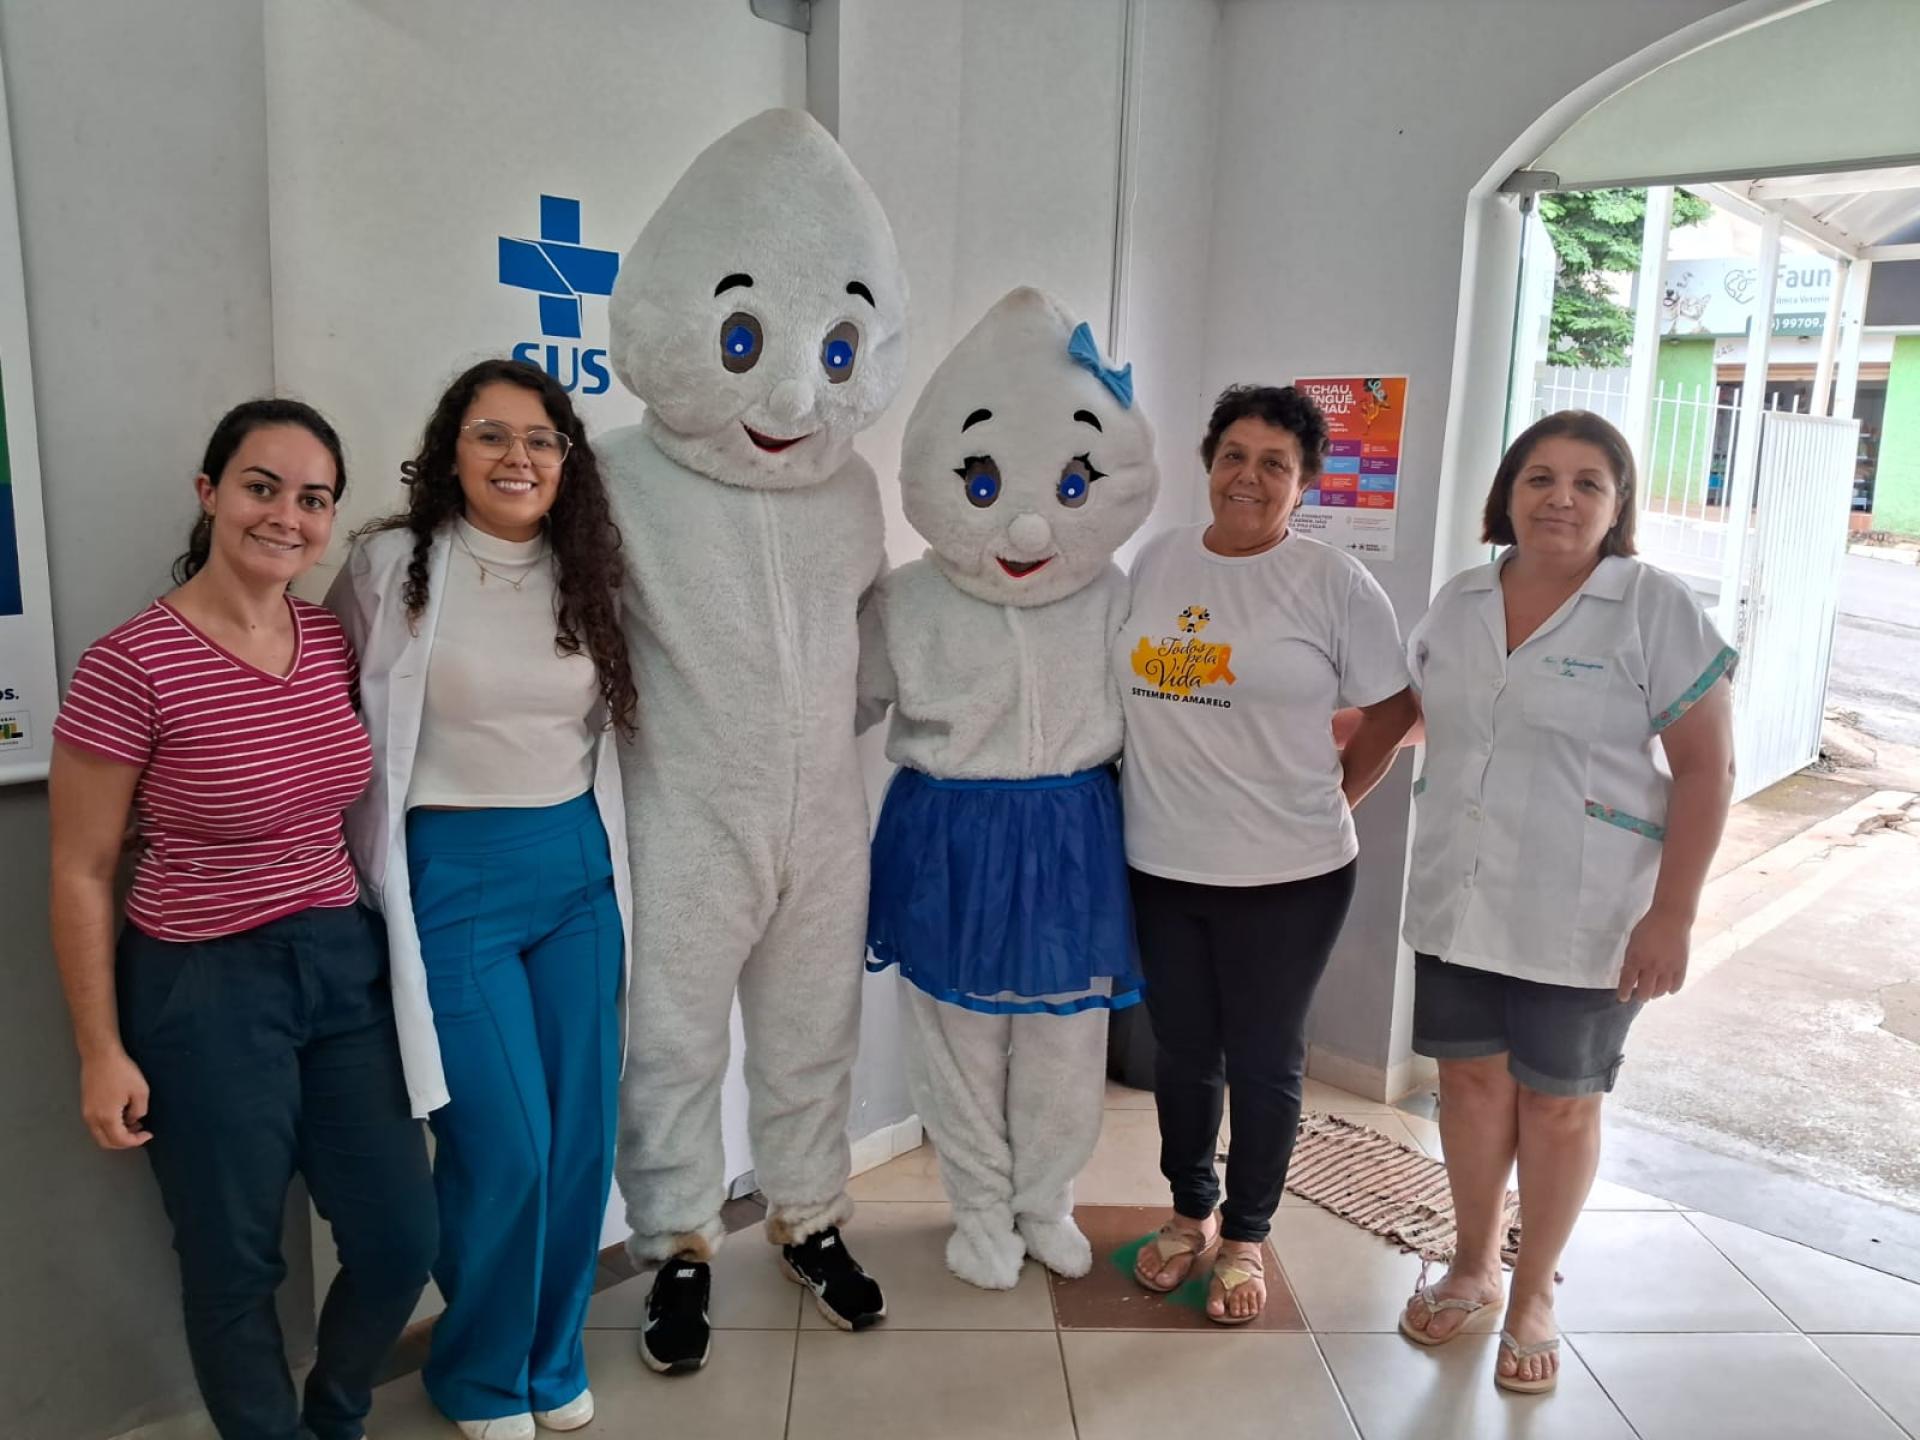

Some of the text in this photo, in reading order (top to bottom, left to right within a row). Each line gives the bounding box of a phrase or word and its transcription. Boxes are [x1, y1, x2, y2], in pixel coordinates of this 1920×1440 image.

[1782, 317, 1825, 329] 99709.
[1304, 384, 1352, 395] TCHAU,
[1158, 636, 1206, 657] Todos
[1145, 657, 1202, 688] Vida
[1131, 687, 1231, 709] SETEMBRO AMARELO
